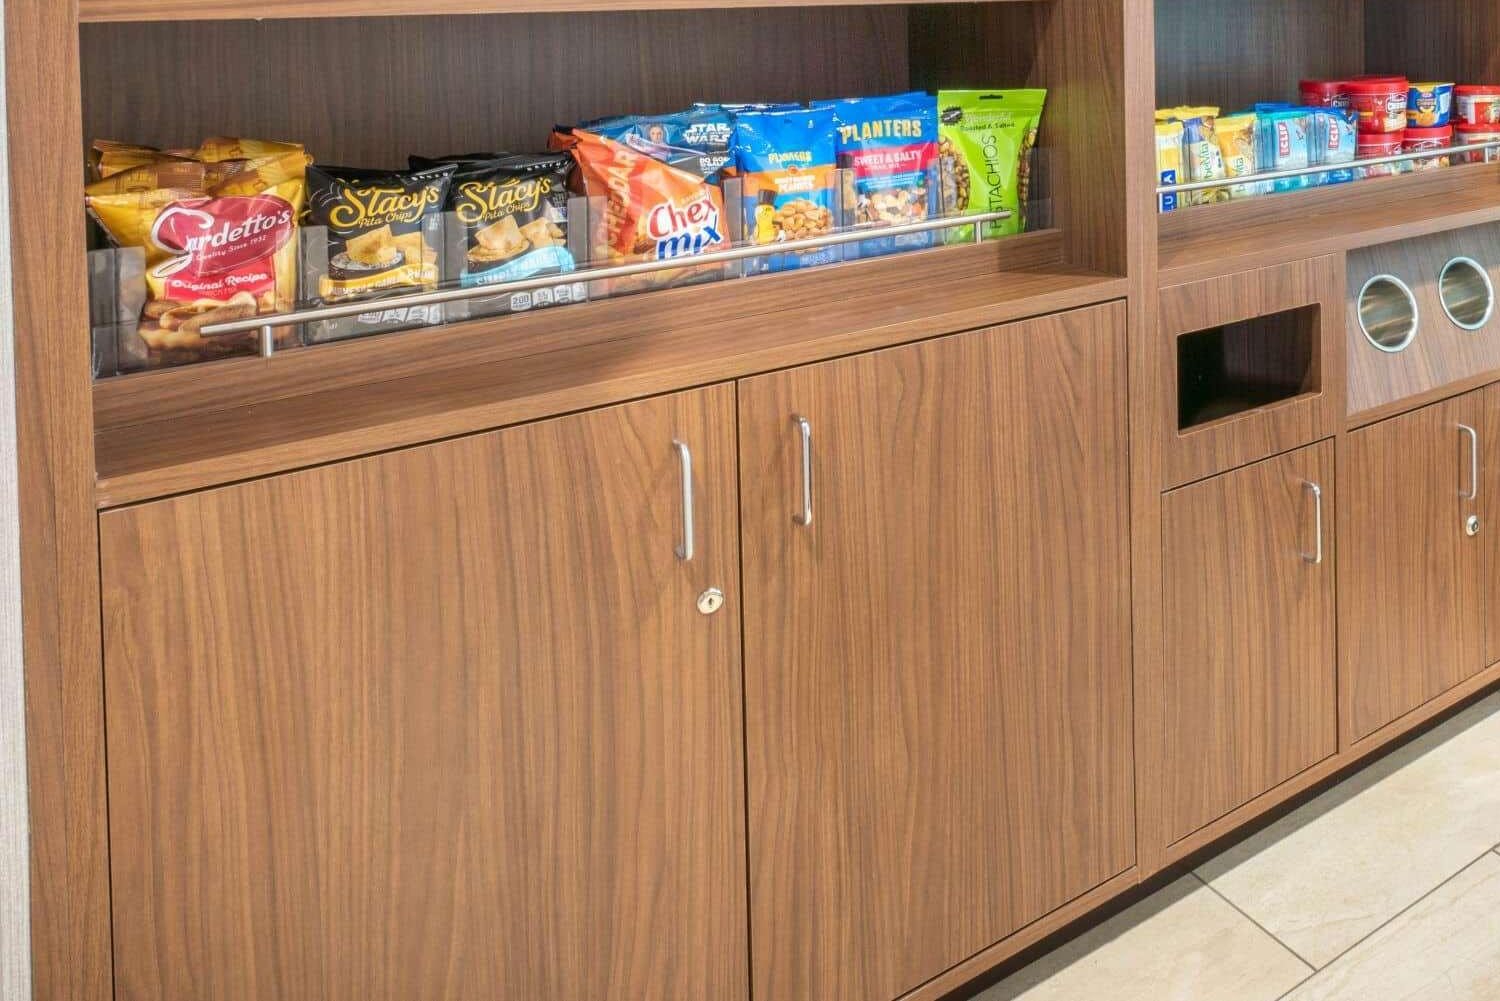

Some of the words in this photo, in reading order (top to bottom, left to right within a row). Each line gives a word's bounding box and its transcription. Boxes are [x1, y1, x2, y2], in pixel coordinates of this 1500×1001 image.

[840, 119, 922, 145] PLANTERS
[854, 155, 885, 168] SWEET
[892, 149, 923, 164] SALTY
[456, 177, 551, 223] Stacy's
[982, 135, 1003, 229] PSTACHIOS
[329, 185, 440, 228] Stacy's
[647, 199, 717, 239] Chex
[656, 213, 722, 261] mix
[171, 278, 225, 291] Original
[224, 272, 268, 287] Recipe
